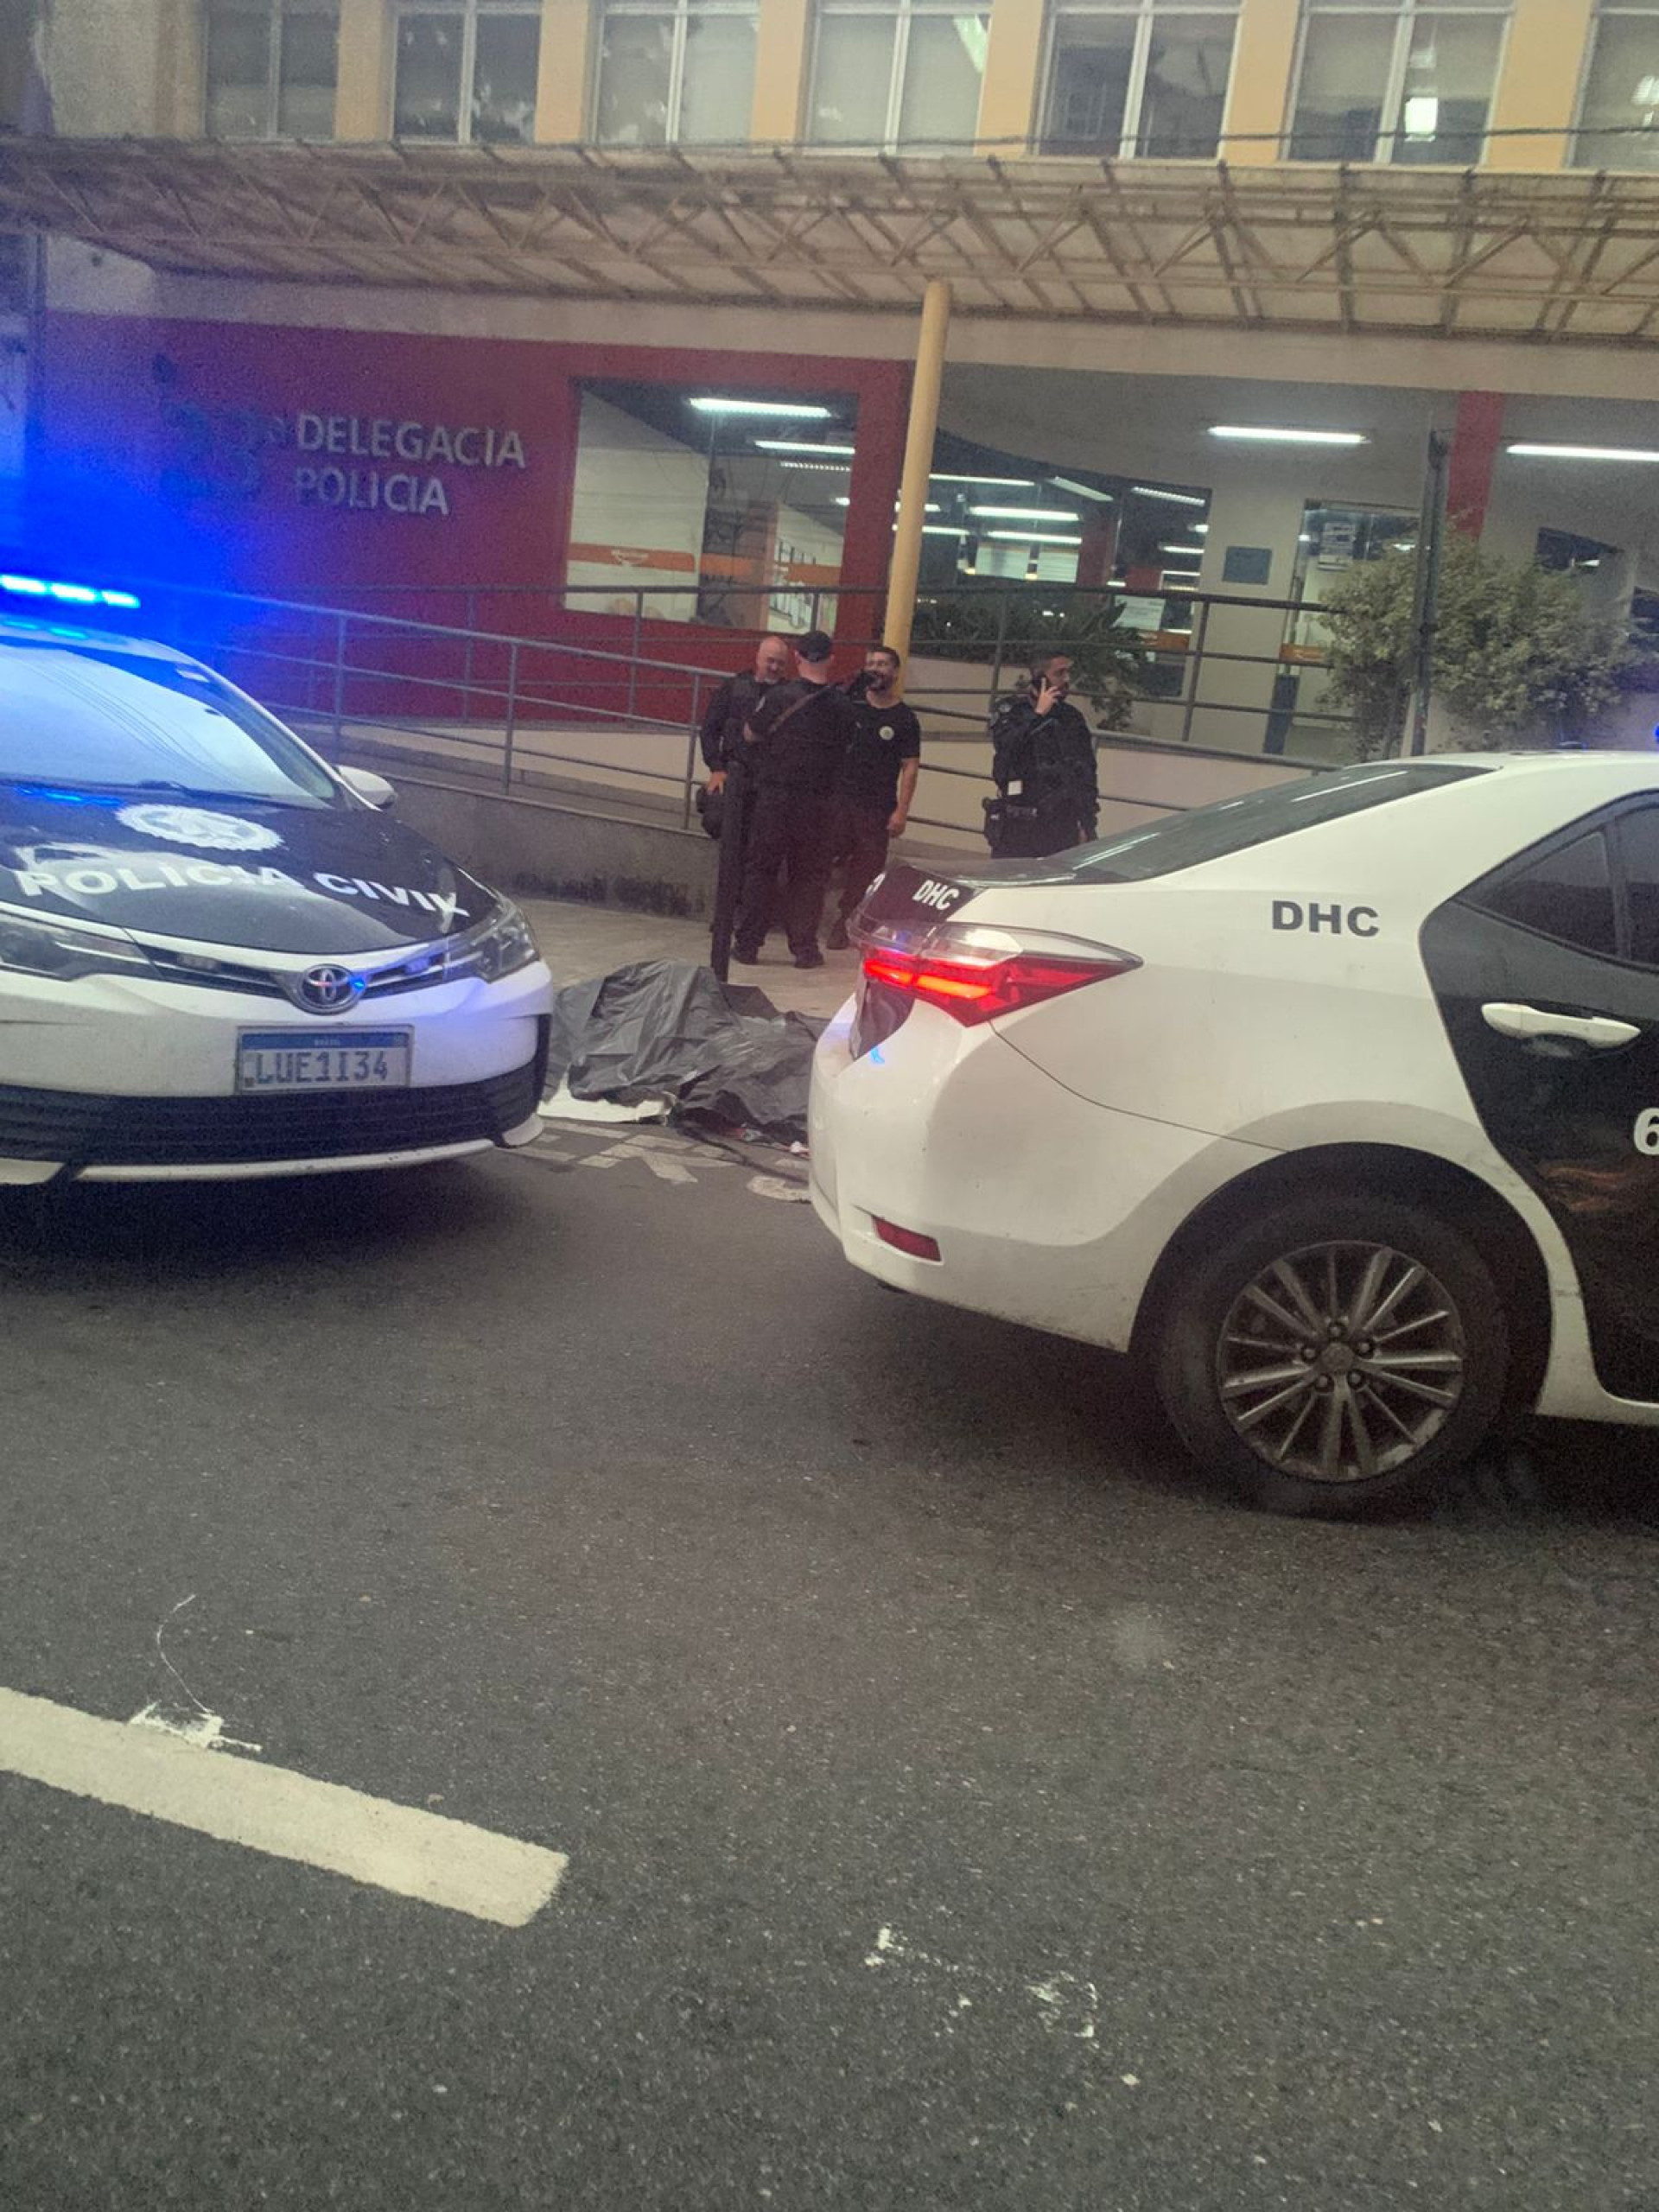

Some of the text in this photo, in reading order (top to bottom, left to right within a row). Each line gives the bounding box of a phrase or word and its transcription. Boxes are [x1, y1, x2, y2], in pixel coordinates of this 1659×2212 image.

[297, 413, 526, 469] DELEGACIA
[912, 879, 960, 911] DHC
[1271, 899, 1381, 938] DHC
[256, 1049, 388, 1084] LUE1I34
[1633, 1107, 1659, 1155] 6
